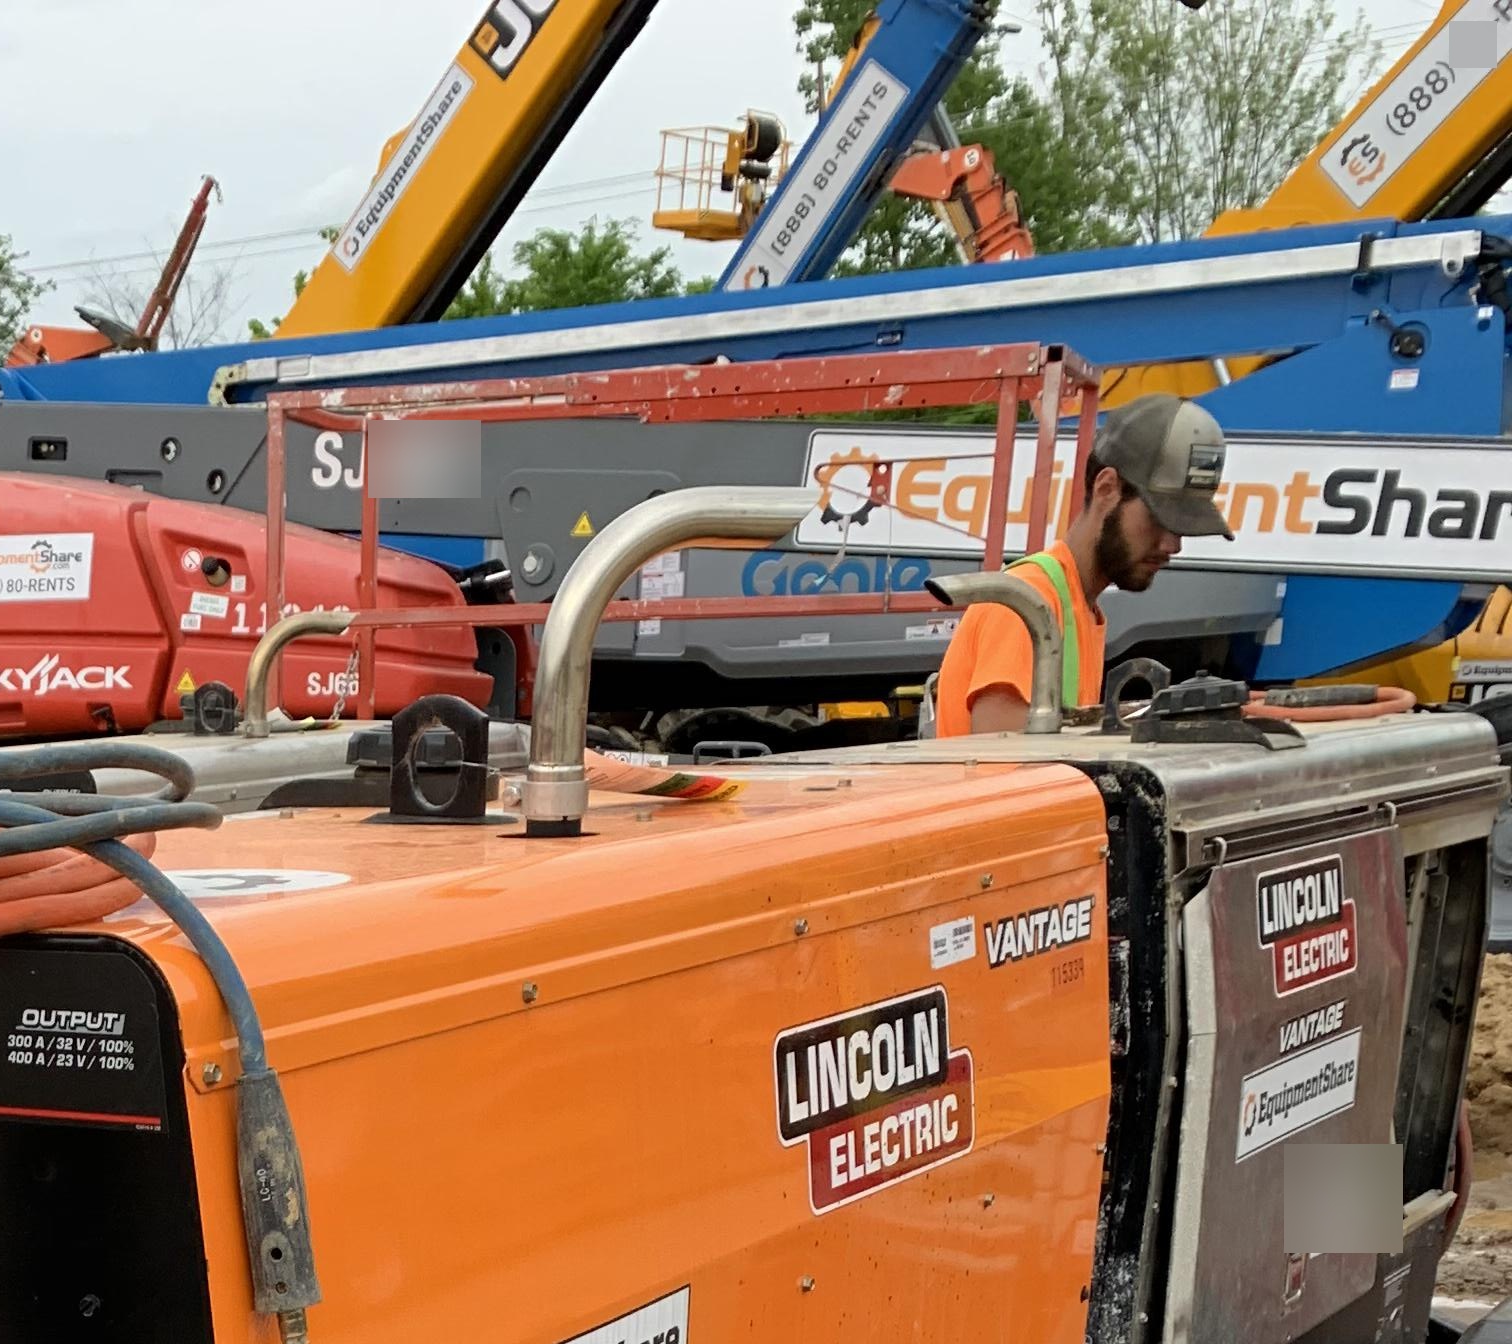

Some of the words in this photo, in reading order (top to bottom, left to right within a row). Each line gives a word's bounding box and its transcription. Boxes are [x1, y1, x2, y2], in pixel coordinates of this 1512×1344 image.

[1386, 60, 1455, 136] (888)
[356, 80, 462, 237] EquipmentShare
[813, 81, 888, 191] 80-RENTS
[6, 577, 76, 593] 80-RENTS
[742, 550, 932, 598] Genie
[985, 898, 1092, 965] VANTAGE
[1262, 869, 1340, 936] LINCOLN
[1283, 928, 1350, 983] ELECTRIC
[7, 1034, 33, 1048] 300
[35, 1036, 45, 1049] A
[46, 1037, 56, 1051] /
[56, 1037, 74, 1050] 32
[76, 1038, 87, 1051] V
[87, 1039, 97, 1053] /
[98, 1040, 135, 1054] 100%
[21, 1008, 119, 1031] OUTPUT
[1280, 1002, 1346, 1053] VANTAGE
[7, 1051, 33, 1064] 400
[35, 1052, 45, 1065] A
[46, 1053, 56, 1068] /
[56, 1054, 74, 1067] 23
[76, 1055, 87, 1068] V
[87, 1056, 97, 1070] /
[98, 1056, 135, 1071] 100%
[786, 1007, 940, 1124] LINCOLN
[1258, 1059, 1356, 1127] EquipmentShare
[829, 1093, 959, 1189] ELECTRIC
